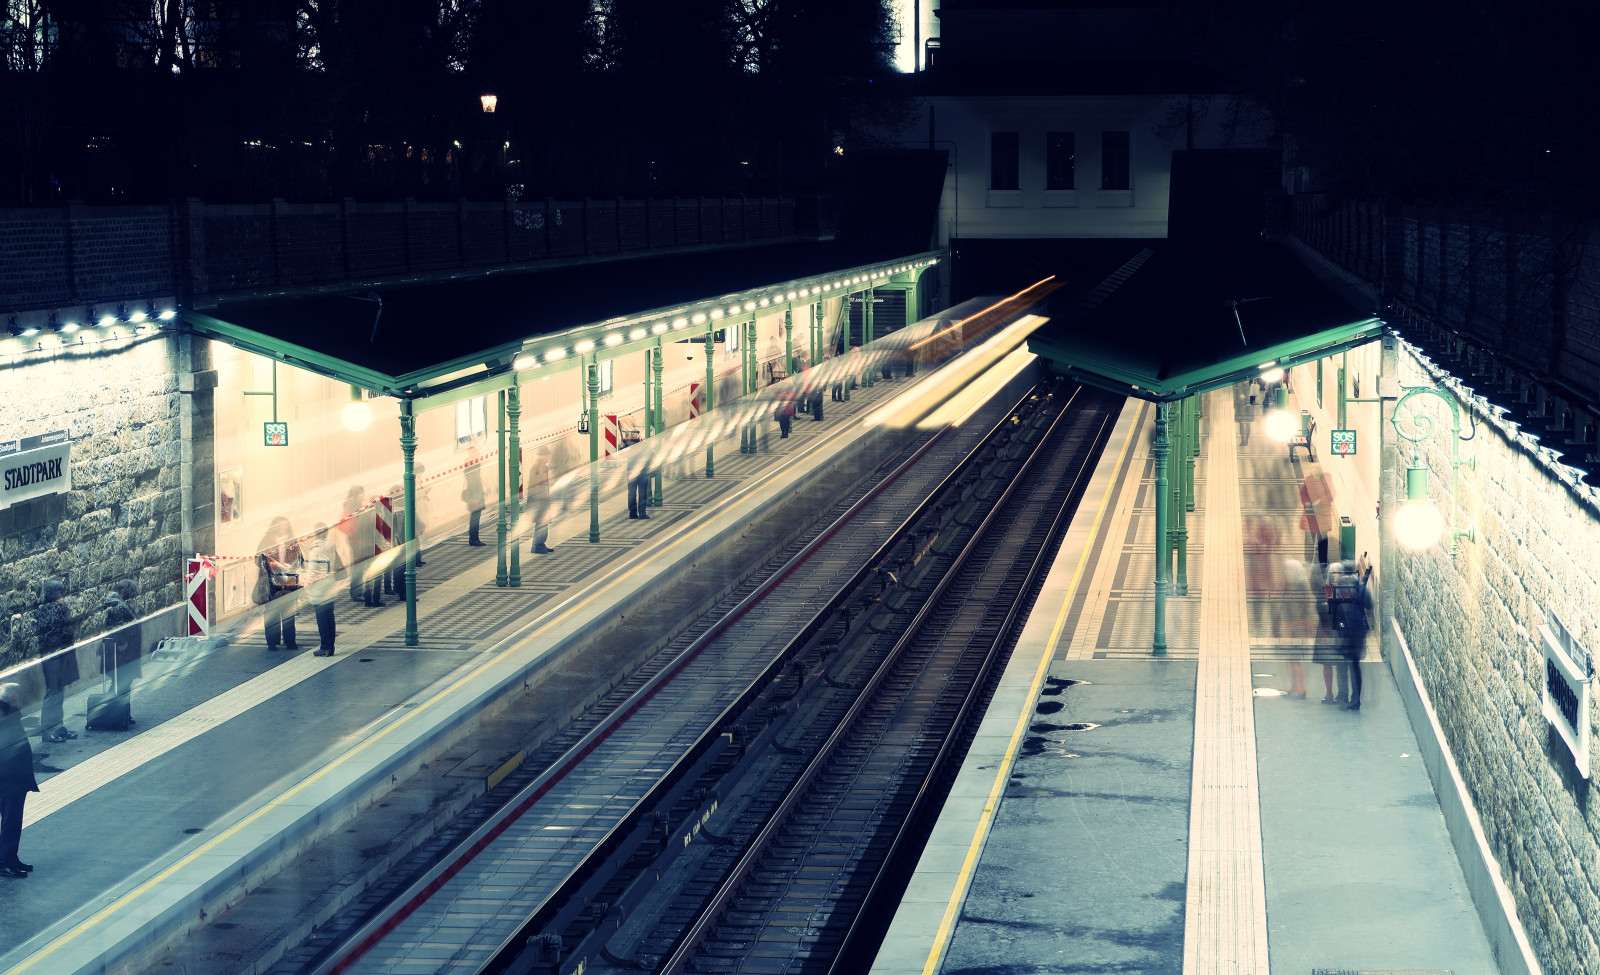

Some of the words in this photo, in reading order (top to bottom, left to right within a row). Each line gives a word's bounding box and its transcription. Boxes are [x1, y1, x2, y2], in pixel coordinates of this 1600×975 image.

[266, 424, 286, 434] SOS
[1333, 431, 1355, 442] SOS
[5, 457, 62, 490] STADTPARK
